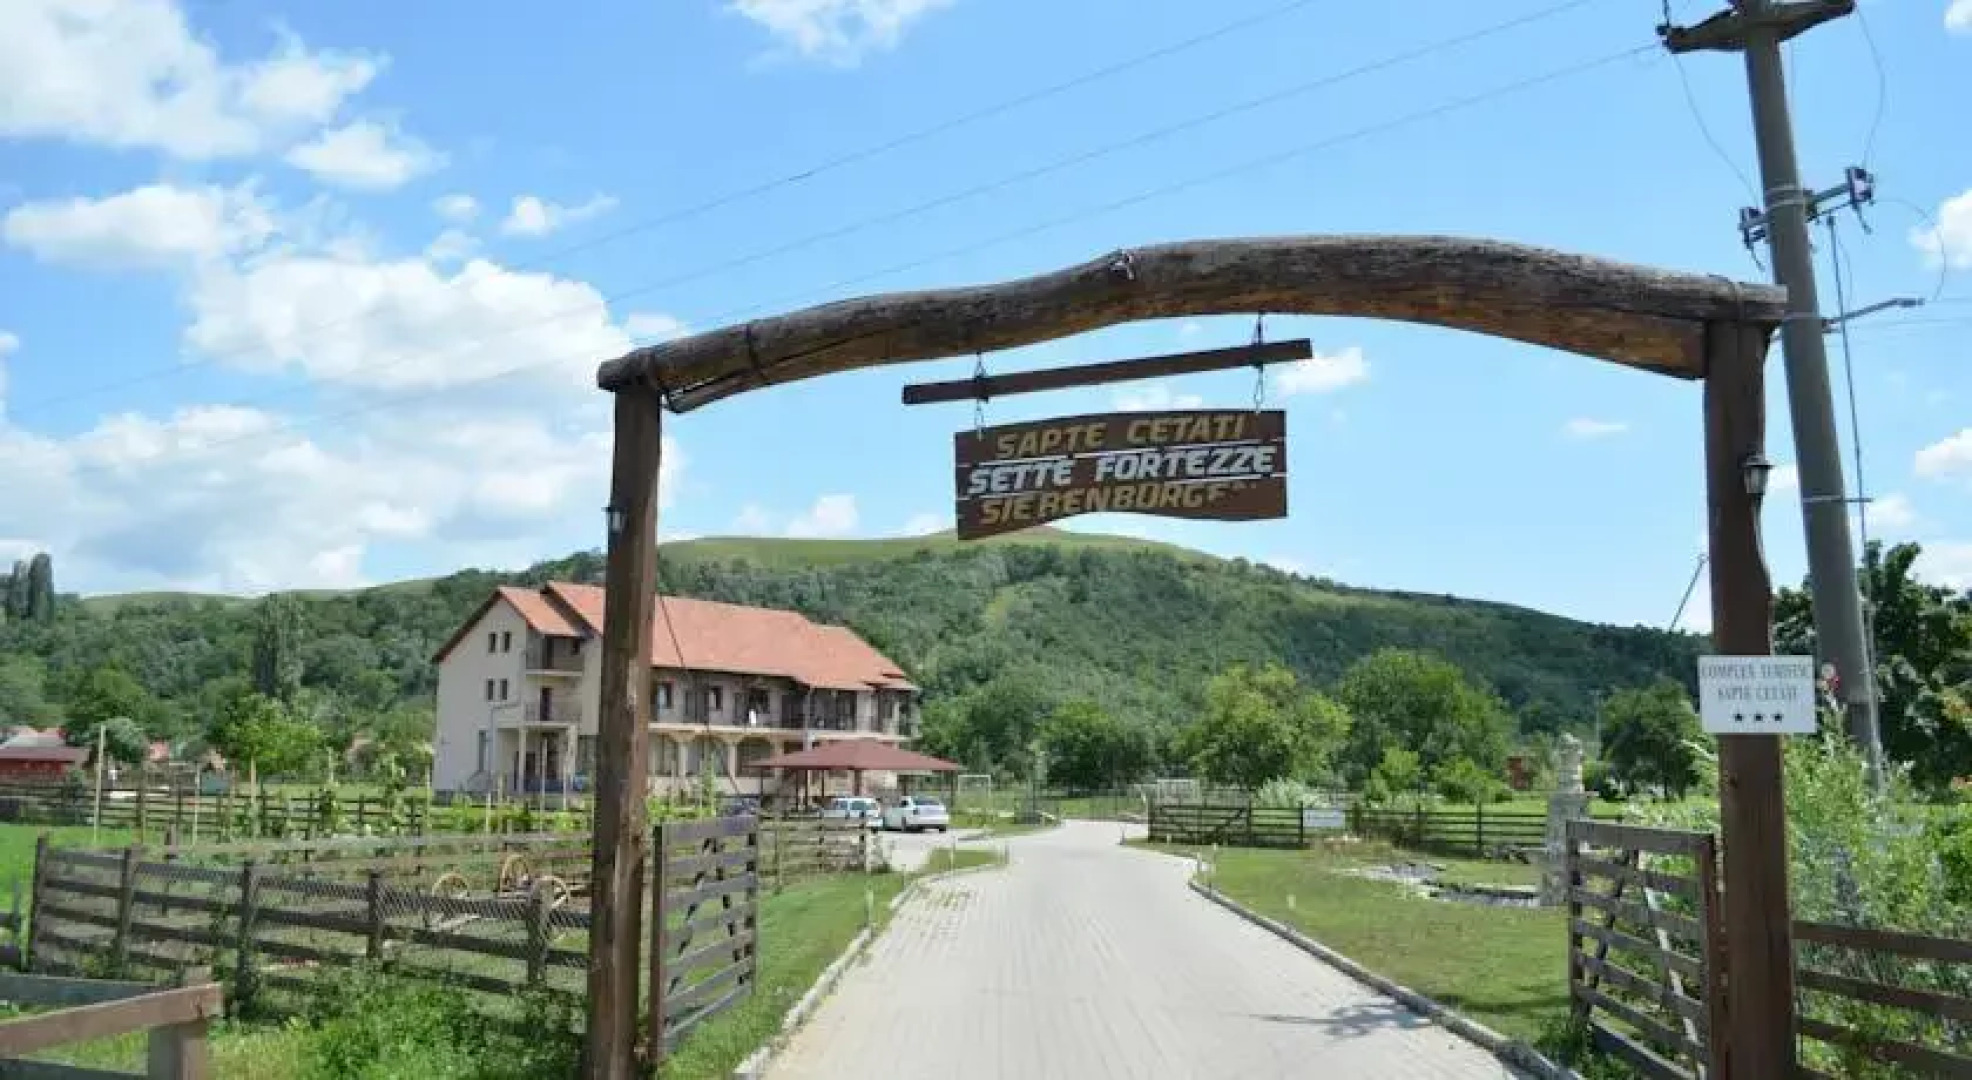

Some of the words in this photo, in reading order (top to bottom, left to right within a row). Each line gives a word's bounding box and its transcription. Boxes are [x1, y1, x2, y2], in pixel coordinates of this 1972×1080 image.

[997, 422, 1107, 458] SAPTE
[1126, 414, 1246, 442] CETATI
[968, 459, 1074, 495] SETTE
[1095, 446, 1277, 482] FORTEZZE
[980, 481, 1258, 524] SIEBENBURGE
